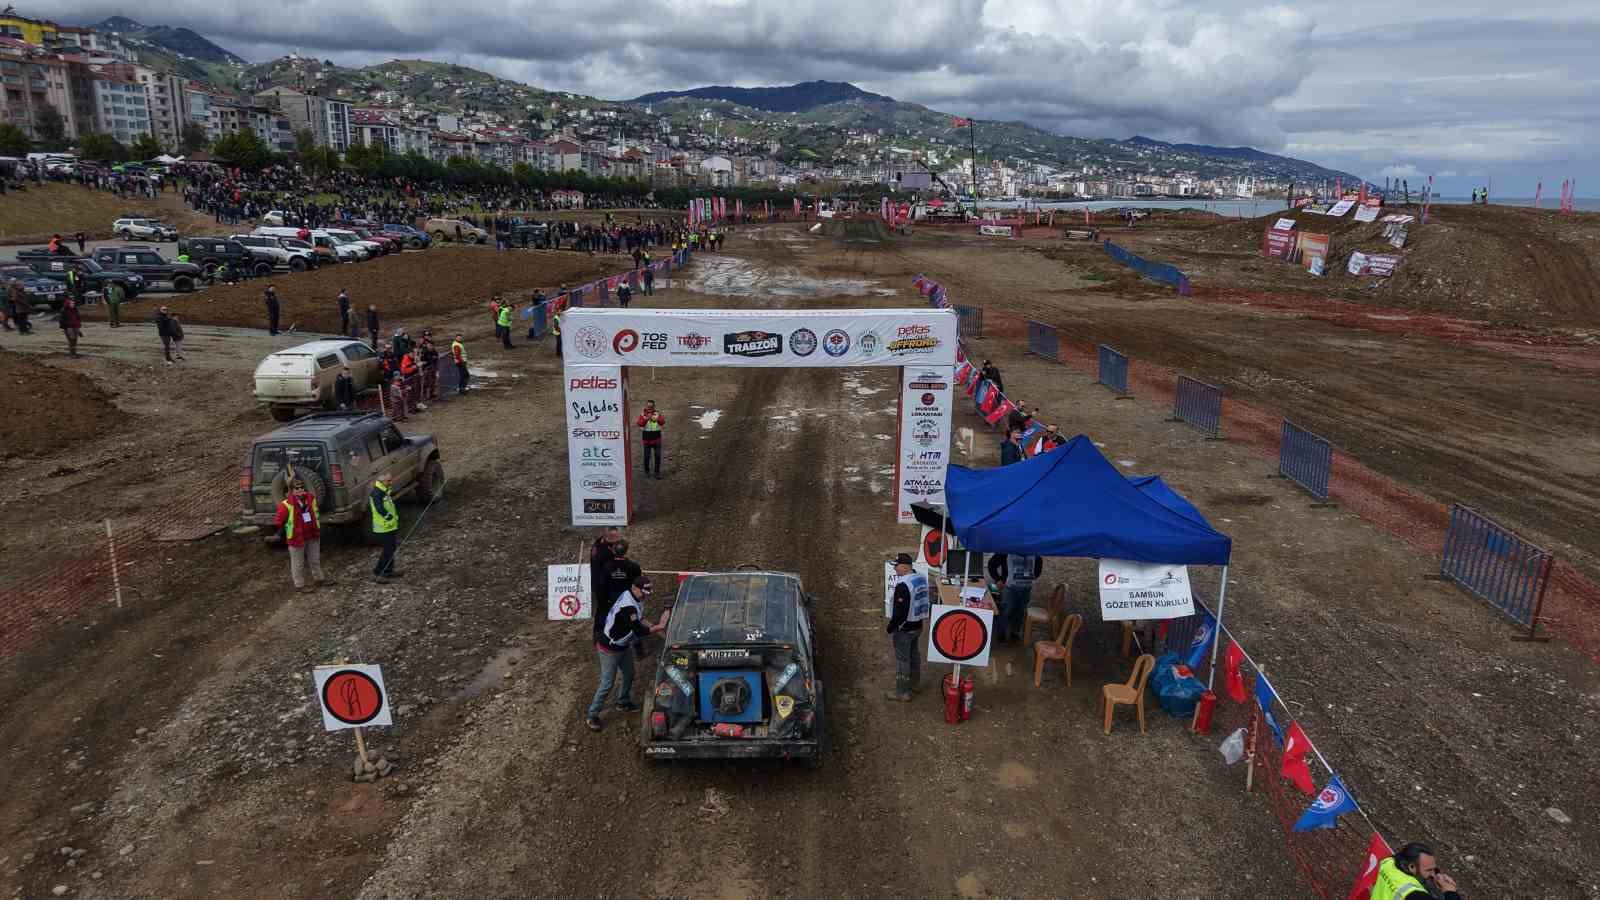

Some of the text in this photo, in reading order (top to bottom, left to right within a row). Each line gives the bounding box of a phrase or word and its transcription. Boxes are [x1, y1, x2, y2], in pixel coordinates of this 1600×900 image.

[642, 332, 668, 342] TOS
[642, 341, 667, 350] FED
[728, 337, 778, 351] TRABZON
[570, 376, 617, 391] petlas
[572, 400, 618, 419] Salados
[582, 447, 610, 458] atc
[920, 451, 942, 459] HTM
[1128, 591, 1165, 599] SAMSUN
[1105, 598, 1189, 609] GÖZETMEN KURULU
[646, 746, 676, 754] ARDA
